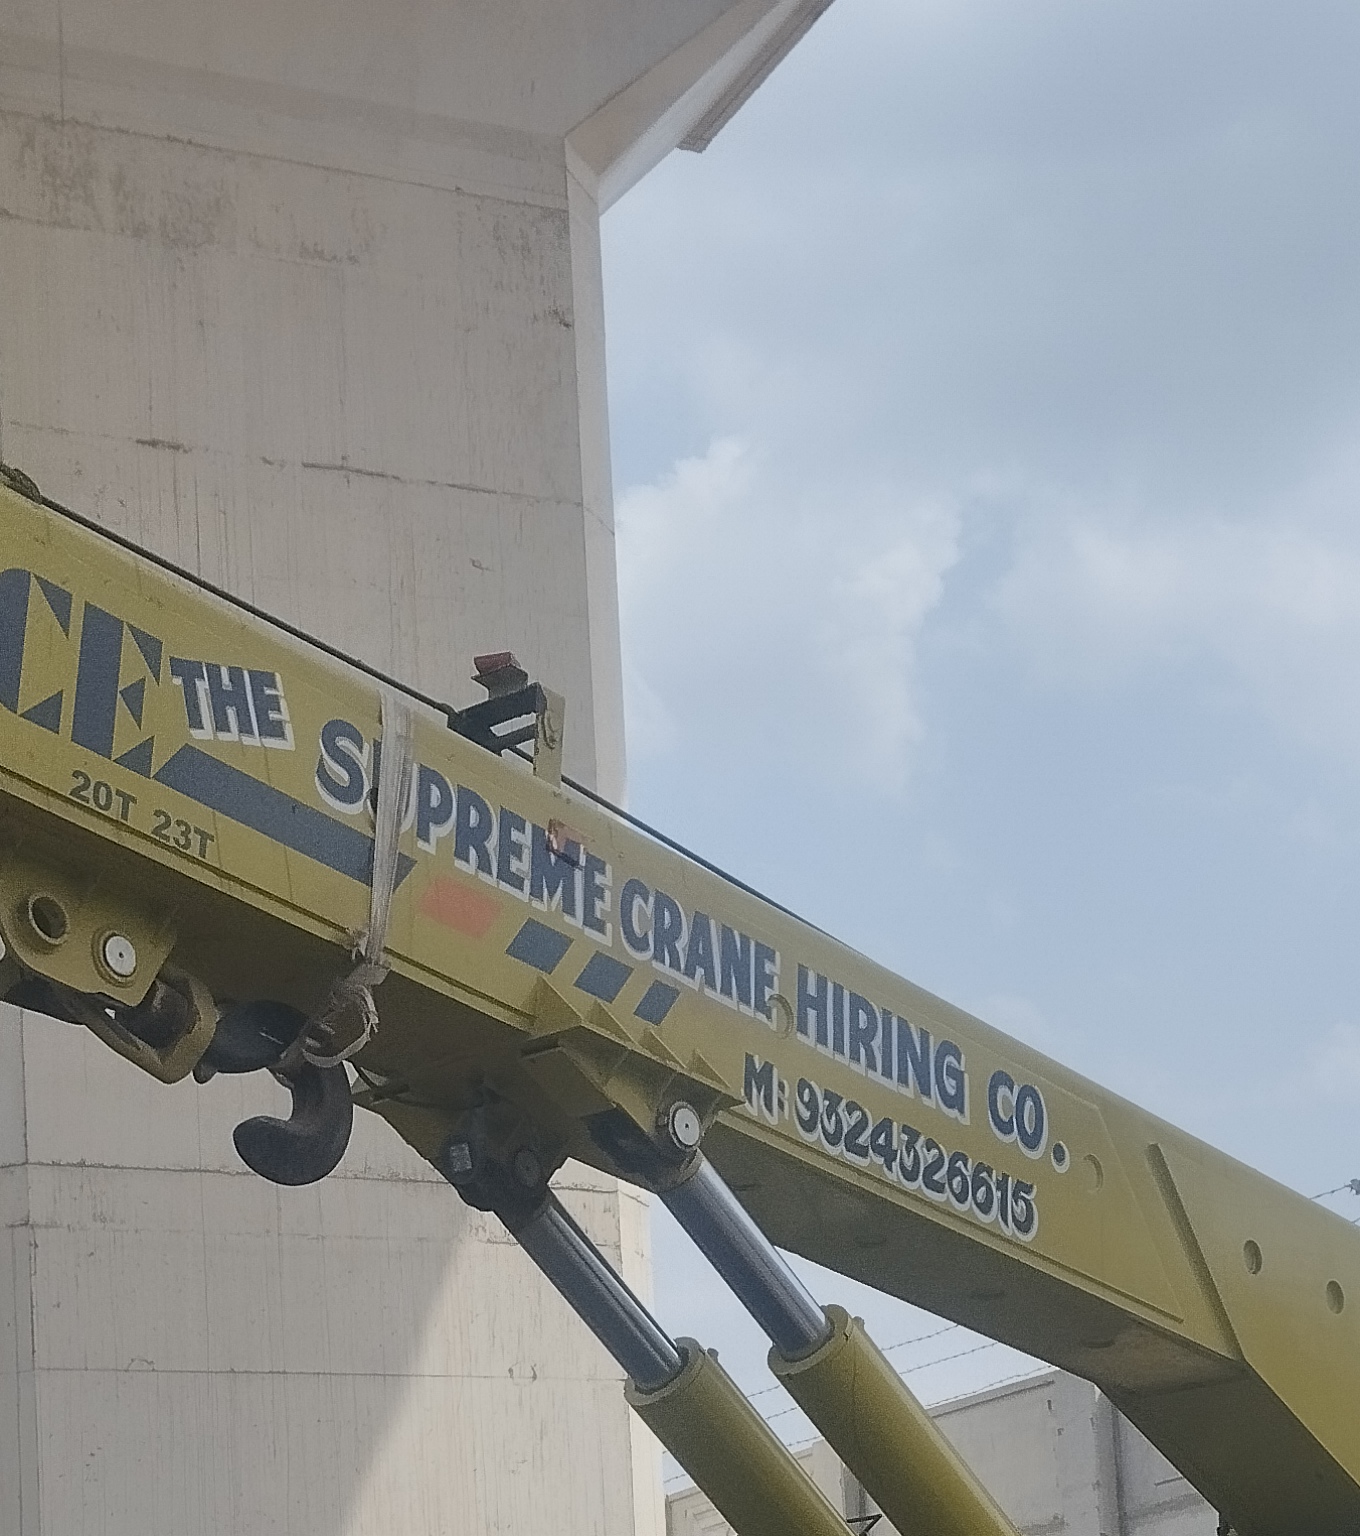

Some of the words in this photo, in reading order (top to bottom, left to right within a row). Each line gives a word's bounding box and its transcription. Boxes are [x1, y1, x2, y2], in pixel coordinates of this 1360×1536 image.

[70, 769, 138, 824] 20T
[152, 809, 216, 860] 23T
[170, 656, 295, 750] THE
[315, 717, 613, 946] SPREME
[620, 878, 780, 1025] CRANE
[795, 963, 970, 1125] HIRING
[986, 1069, 1071, 1173] CO.
[795, 1078, 1039, 1241] 9324326615
